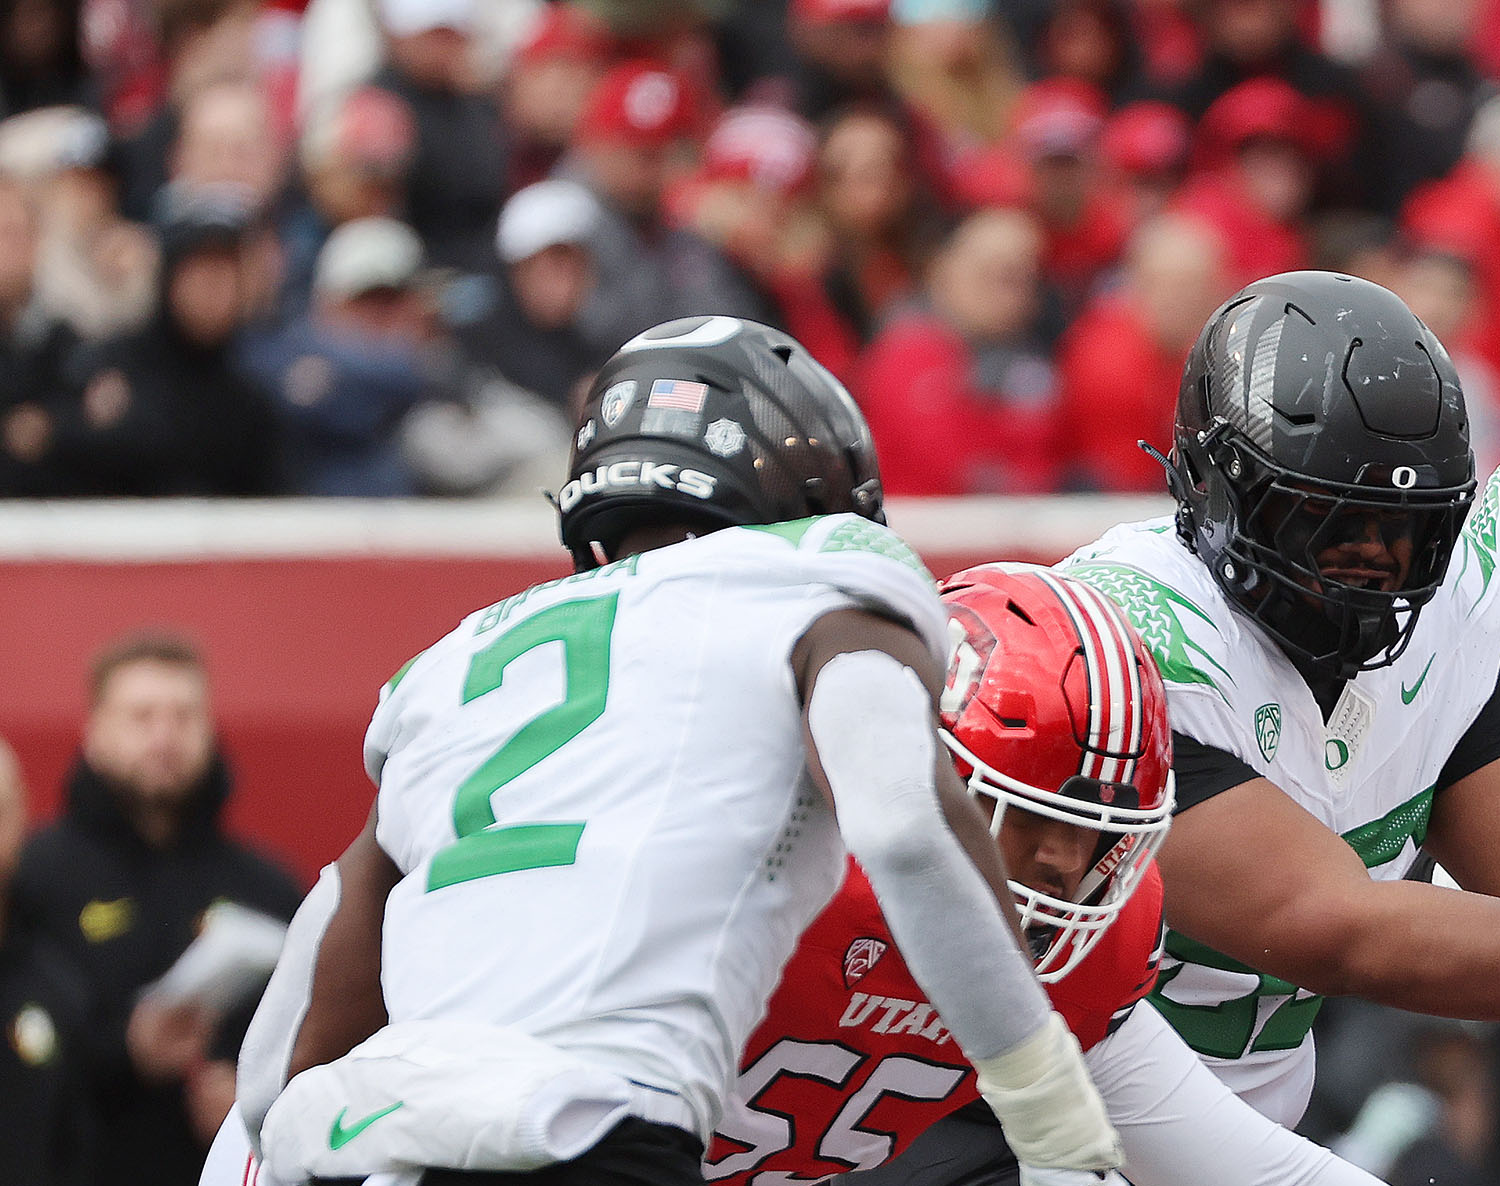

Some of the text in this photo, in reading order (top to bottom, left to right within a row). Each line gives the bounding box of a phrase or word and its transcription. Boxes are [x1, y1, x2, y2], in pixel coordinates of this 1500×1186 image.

[560, 461, 718, 514] DUCKS
[1391, 466, 1417, 488] O
[1256, 706, 1280, 741] PAC
[425, 590, 619, 893] 2
[1263, 730, 1276, 751] 12
[1325, 739, 1349, 771] O
[845, 958, 868, 977] 12
